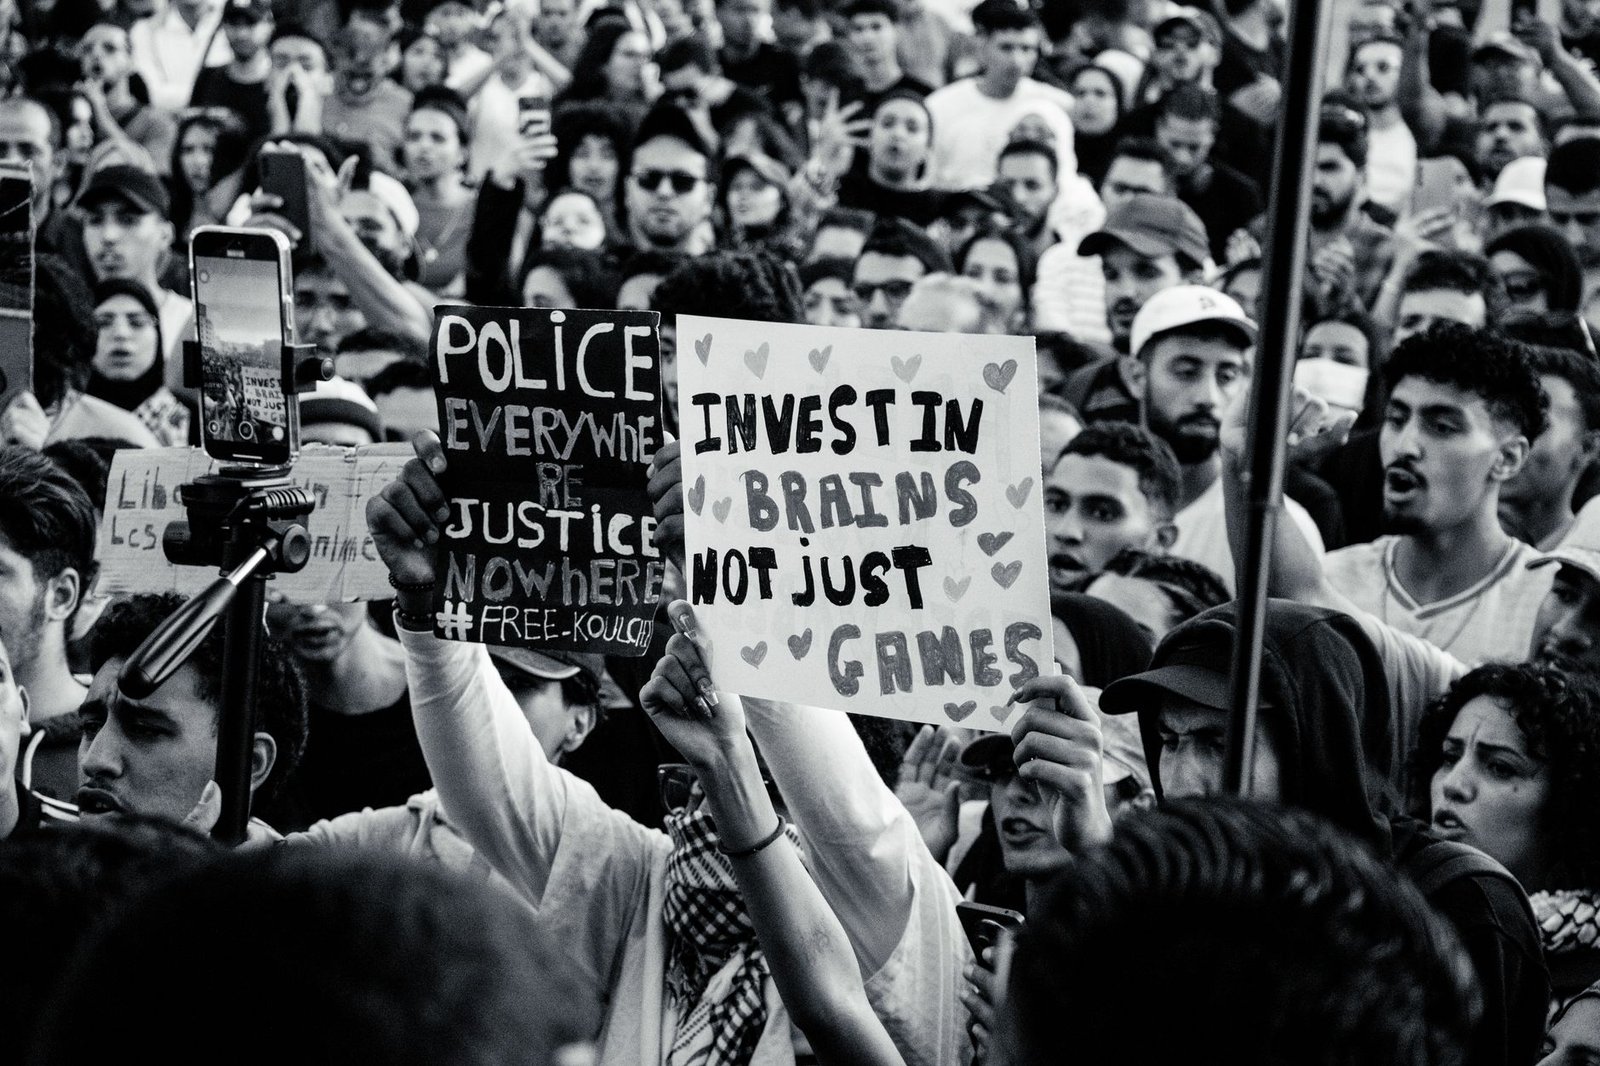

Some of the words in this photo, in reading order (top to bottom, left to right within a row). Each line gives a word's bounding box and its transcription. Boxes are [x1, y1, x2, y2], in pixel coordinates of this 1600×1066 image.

[692, 385, 896, 455] INVEST
[910, 391, 984, 455] IN
[536, 462, 584, 508] RE
[739, 460, 981, 534] BRAINS
[692, 547, 778, 606] NOT
[827, 621, 1043, 698] GAMES
